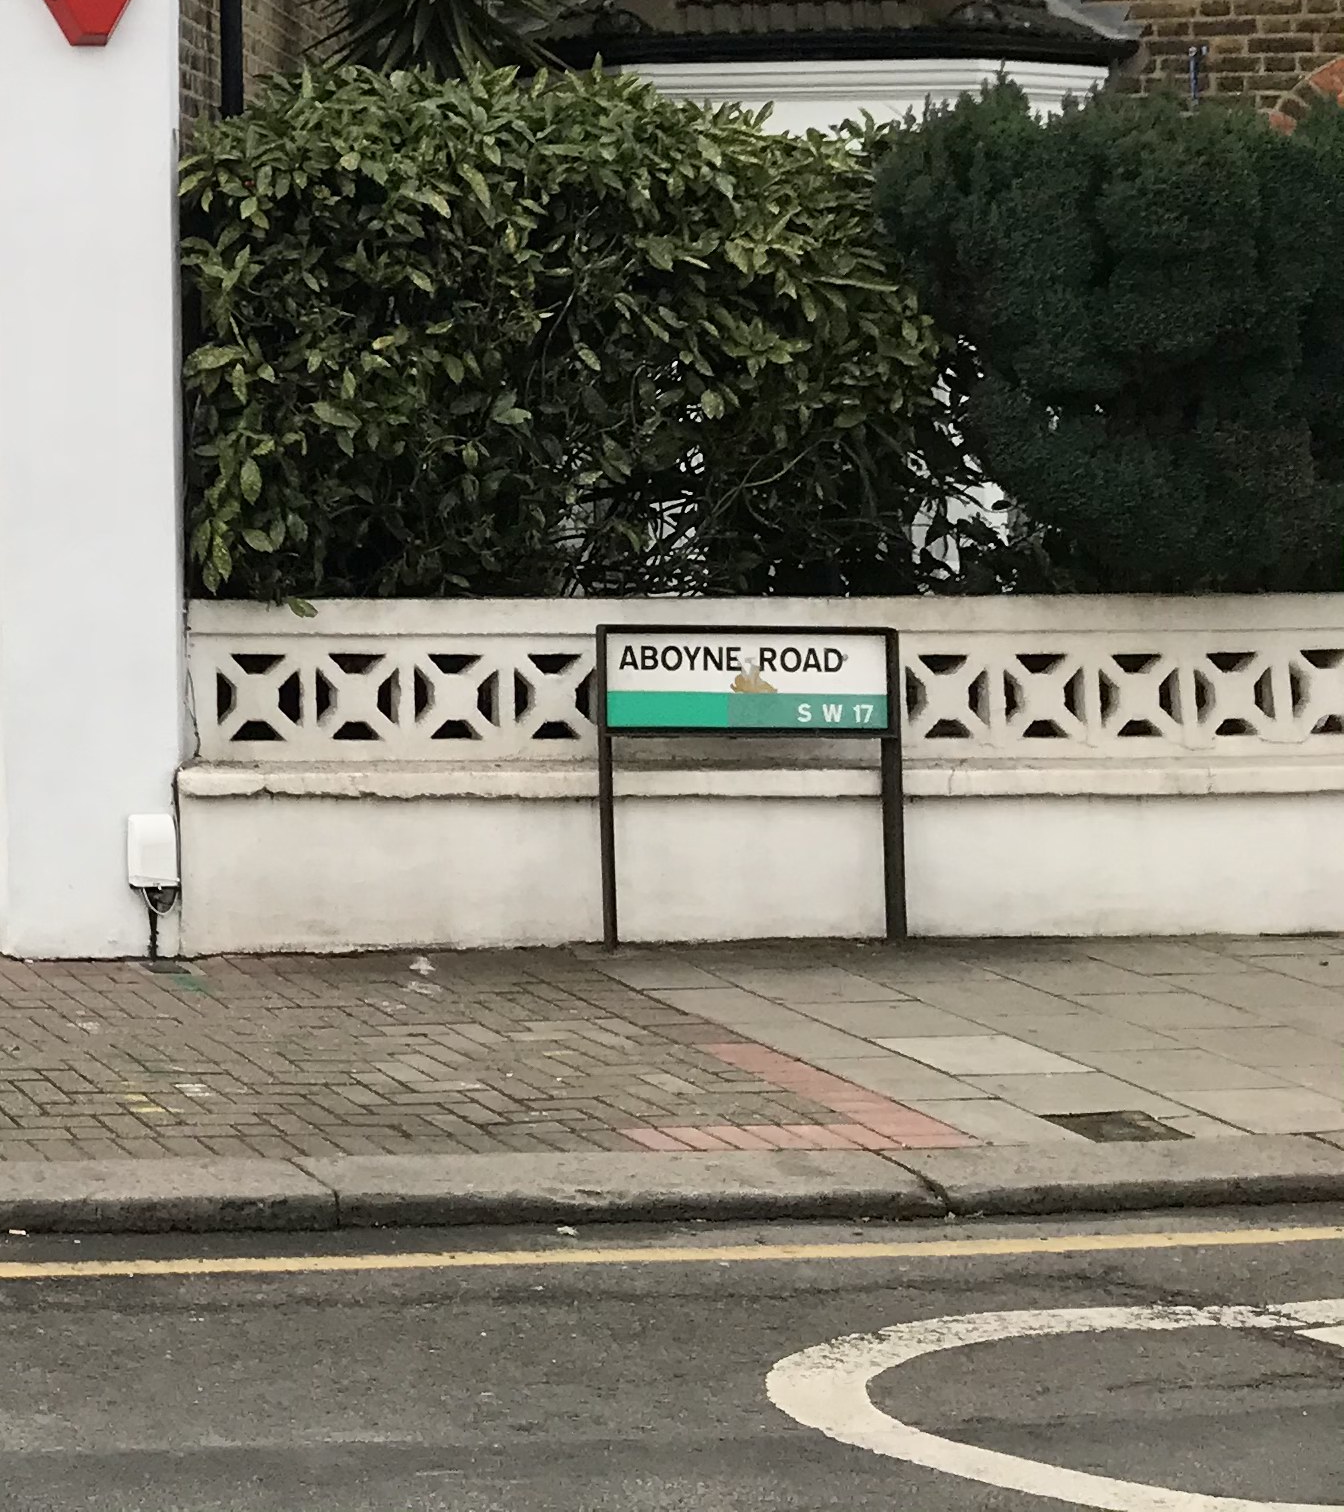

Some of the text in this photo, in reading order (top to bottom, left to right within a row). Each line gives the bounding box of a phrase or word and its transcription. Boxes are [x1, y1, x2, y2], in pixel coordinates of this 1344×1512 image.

[618, 645, 845, 674] ABOYNE ROAD
[852, 703, 875, 724] 17
